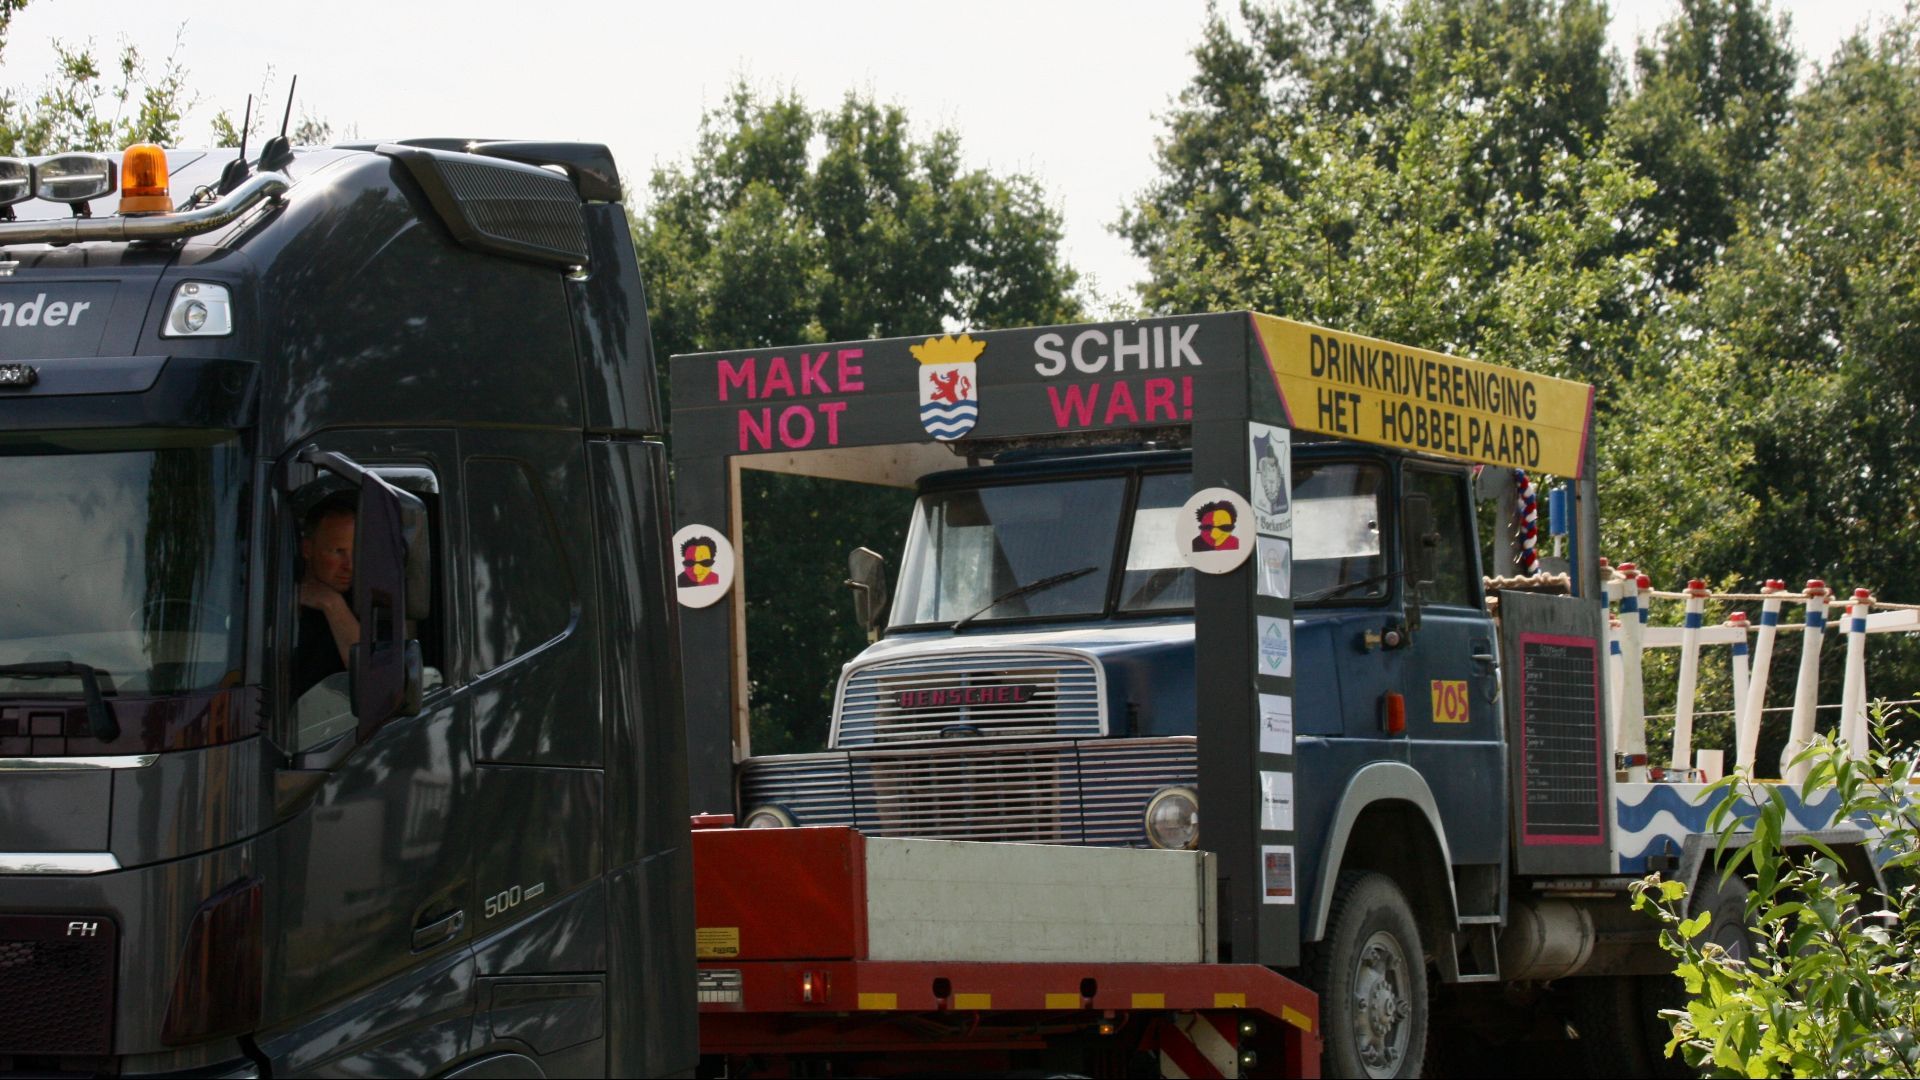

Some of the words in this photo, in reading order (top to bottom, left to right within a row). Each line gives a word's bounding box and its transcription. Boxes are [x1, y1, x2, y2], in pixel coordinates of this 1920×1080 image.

[717, 348, 865, 401] MAKE
[1033, 324, 1203, 376] SCHIK
[1310, 333, 1537, 421] DRINKRIJVERENIGING
[738, 401, 848, 451] NOT
[1047, 375, 1194, 428] WAR!
[1317, 387, 1361, 435] HET
[1381, 399, 1540, 468] HOBBELPAARD
[901, 686, 1025, 708] HENSCHEL
[1432, 681, 1469, 721] 705
[67, 921, 98, 937] FH
[484, 884, 521, 919] 500
